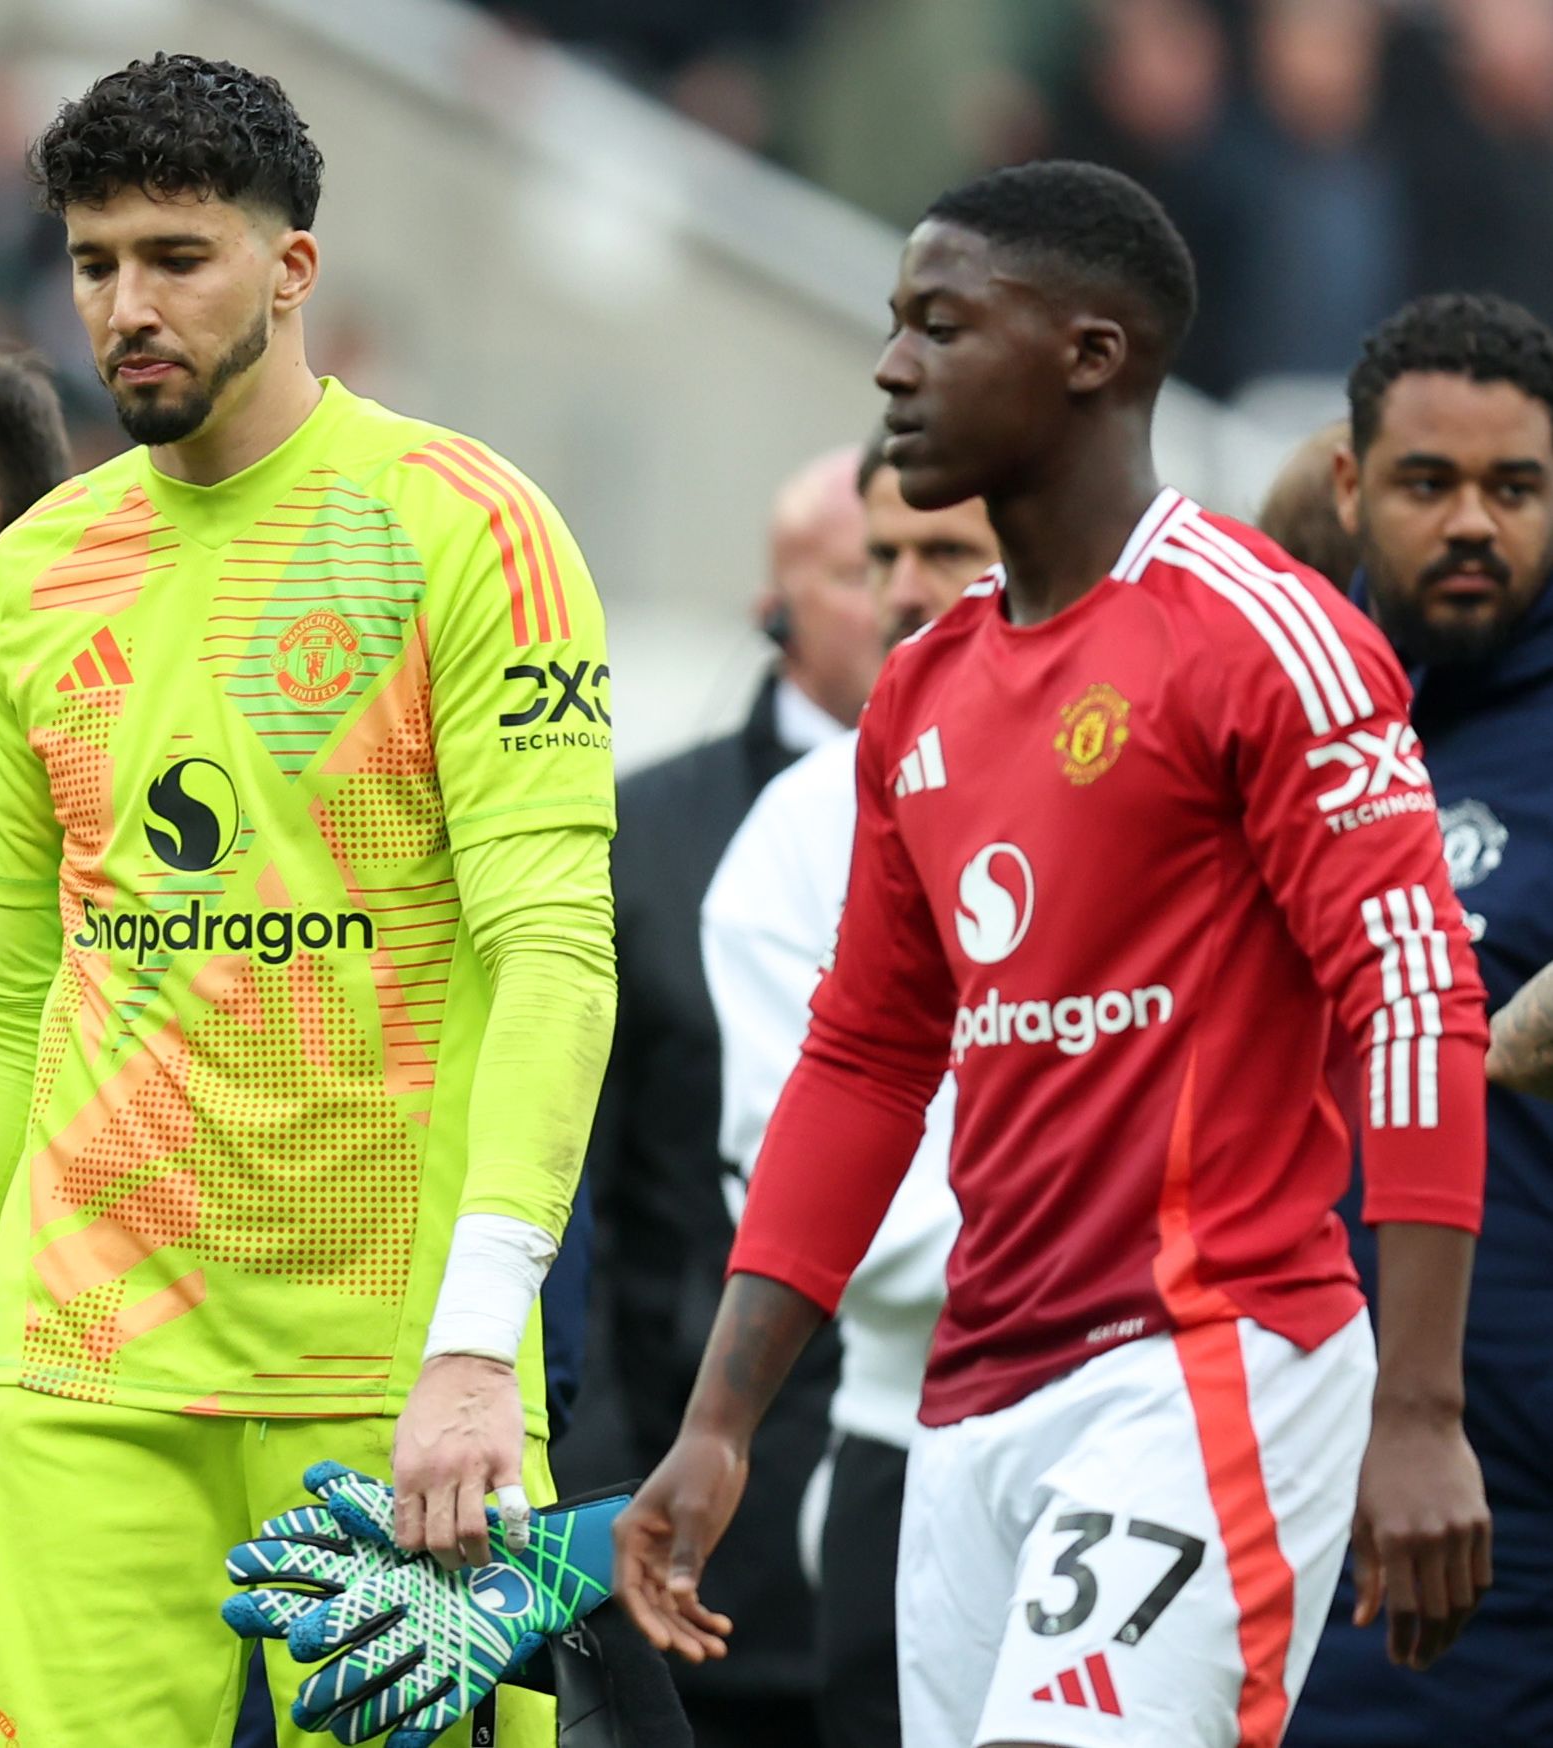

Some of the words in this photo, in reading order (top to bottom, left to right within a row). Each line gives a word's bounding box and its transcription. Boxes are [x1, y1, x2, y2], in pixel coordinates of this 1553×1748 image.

[283, 615, 353, 648] MANCHESTER
[288, 683, 339, 701] UNITED
[499, 731, 612, 753] TECHNOLO
[73, 897, 374, 965] Snapdragon
[950, 984, 1174, 1066] pdragon
[1026, 1512, 1207, 1647] 37
